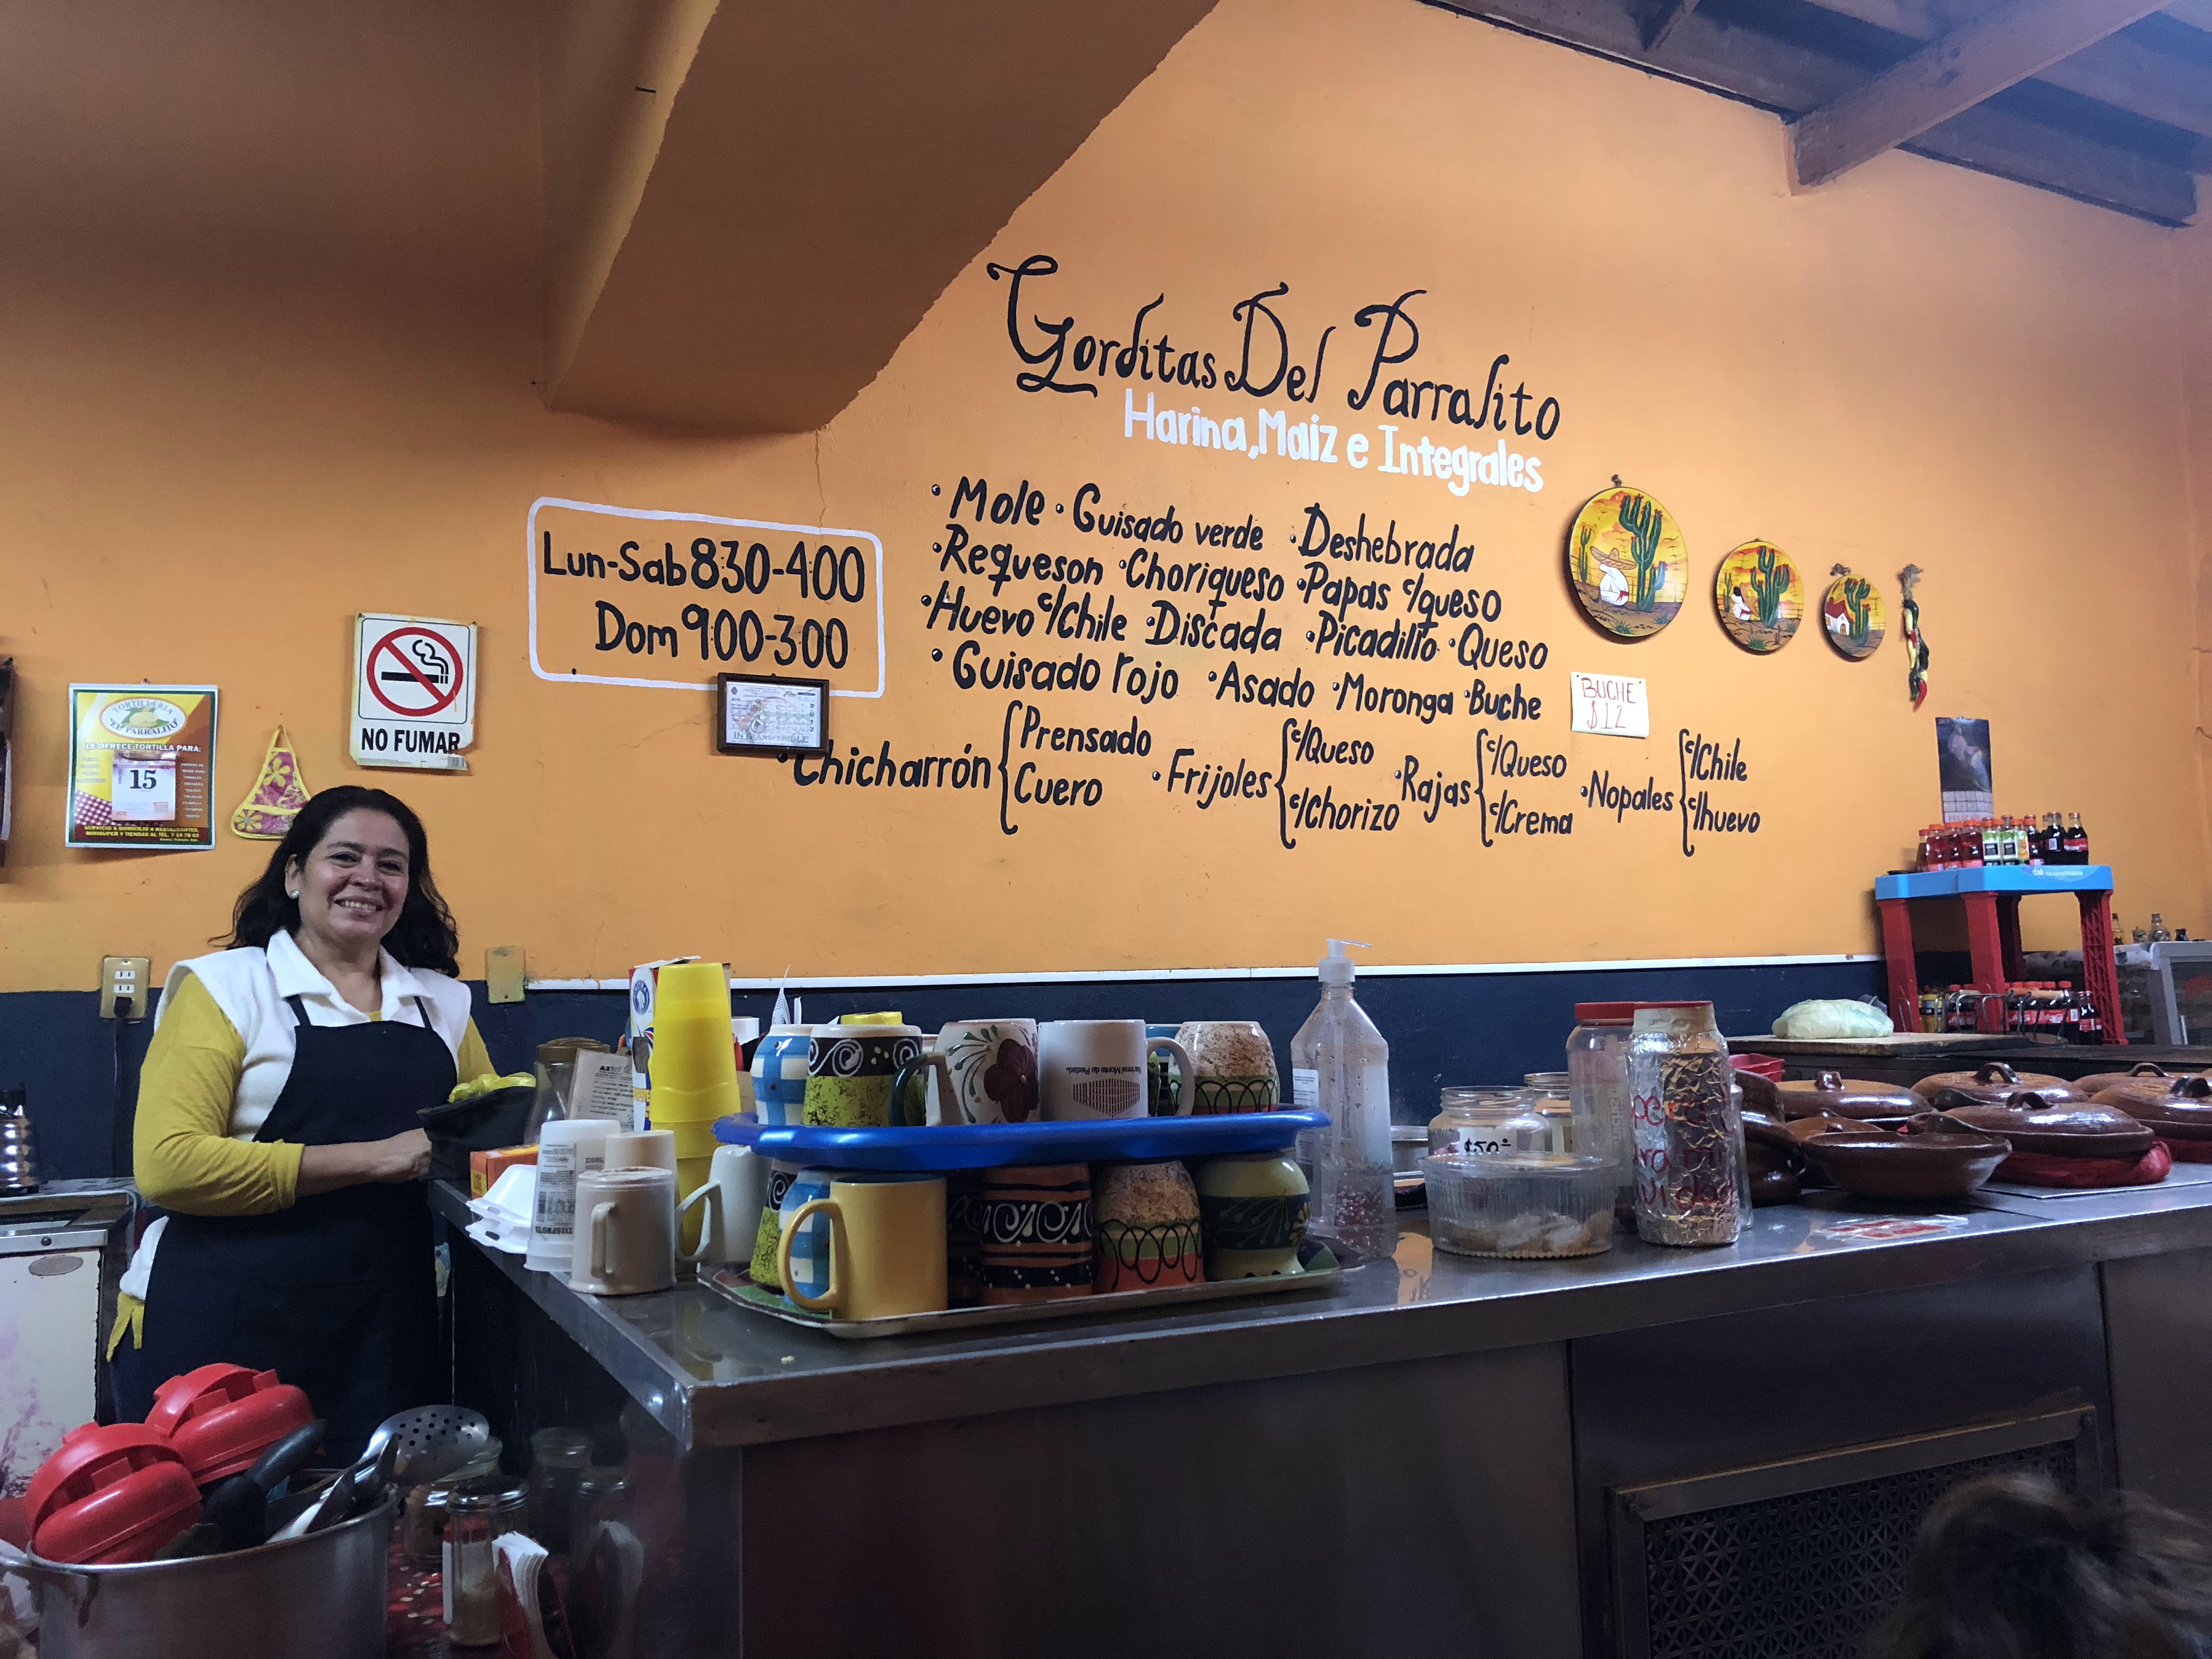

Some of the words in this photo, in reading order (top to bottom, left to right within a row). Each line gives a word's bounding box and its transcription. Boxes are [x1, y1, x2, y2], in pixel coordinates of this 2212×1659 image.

[986, 255, 1216, 398] Gorditas
[1224, 282, 1336, 403] Del
[1348, 290, 1560, 440] Parralito
[1347, 434, 1369, 469] e
[1378, 425, 1544, 496] Integrales
[950, 476, 1045, 526] Mole
[1074, 483, 1183, 543] Guisado
[1196, 515, 1263, 550] verde
[1299, 503, 1474, 572] Deshebrada
[940, 524, 1103, 597] Requeson
[1126, 548, 1284, 620] Choriqueso
[1304, 562, 1391, 622] Papas
[595, 600, 678, 657] Dom
[927, 580, 1034, 636] Huevo
[1146, 600, 1281, 654] Discada
[1316, 610, 1438, 662] Picadillo
[1458, 623, 1548, 670] Queso
[111, 700, 173, 715] TORTILLERIA
[953, 640, 1100, 691] Guisado
[1113, 652, 1178, 704] rojo
[1216, 661, 1314, 707] Asado
[1336, 673, 1453, 724] Moronga
[1469, 679, 1541, 720] Buche
[1581, 678, 1635, 703] BUCHE
[362, 728, 388, 751] NO
[394, 729, 460, 754] FUMAR
[1020, 706, 1151, 756] Prensado
[1587, 700, 1626, 730] $12
[130, 769, 156, 789] 15
[1014, 762, 1102, 806] Cuero
[1168, 749, 1272, 809] Frijoles
[1402, 755, 1471, 823] Rajas
[1589, 770, 1673, 822] Nopales
